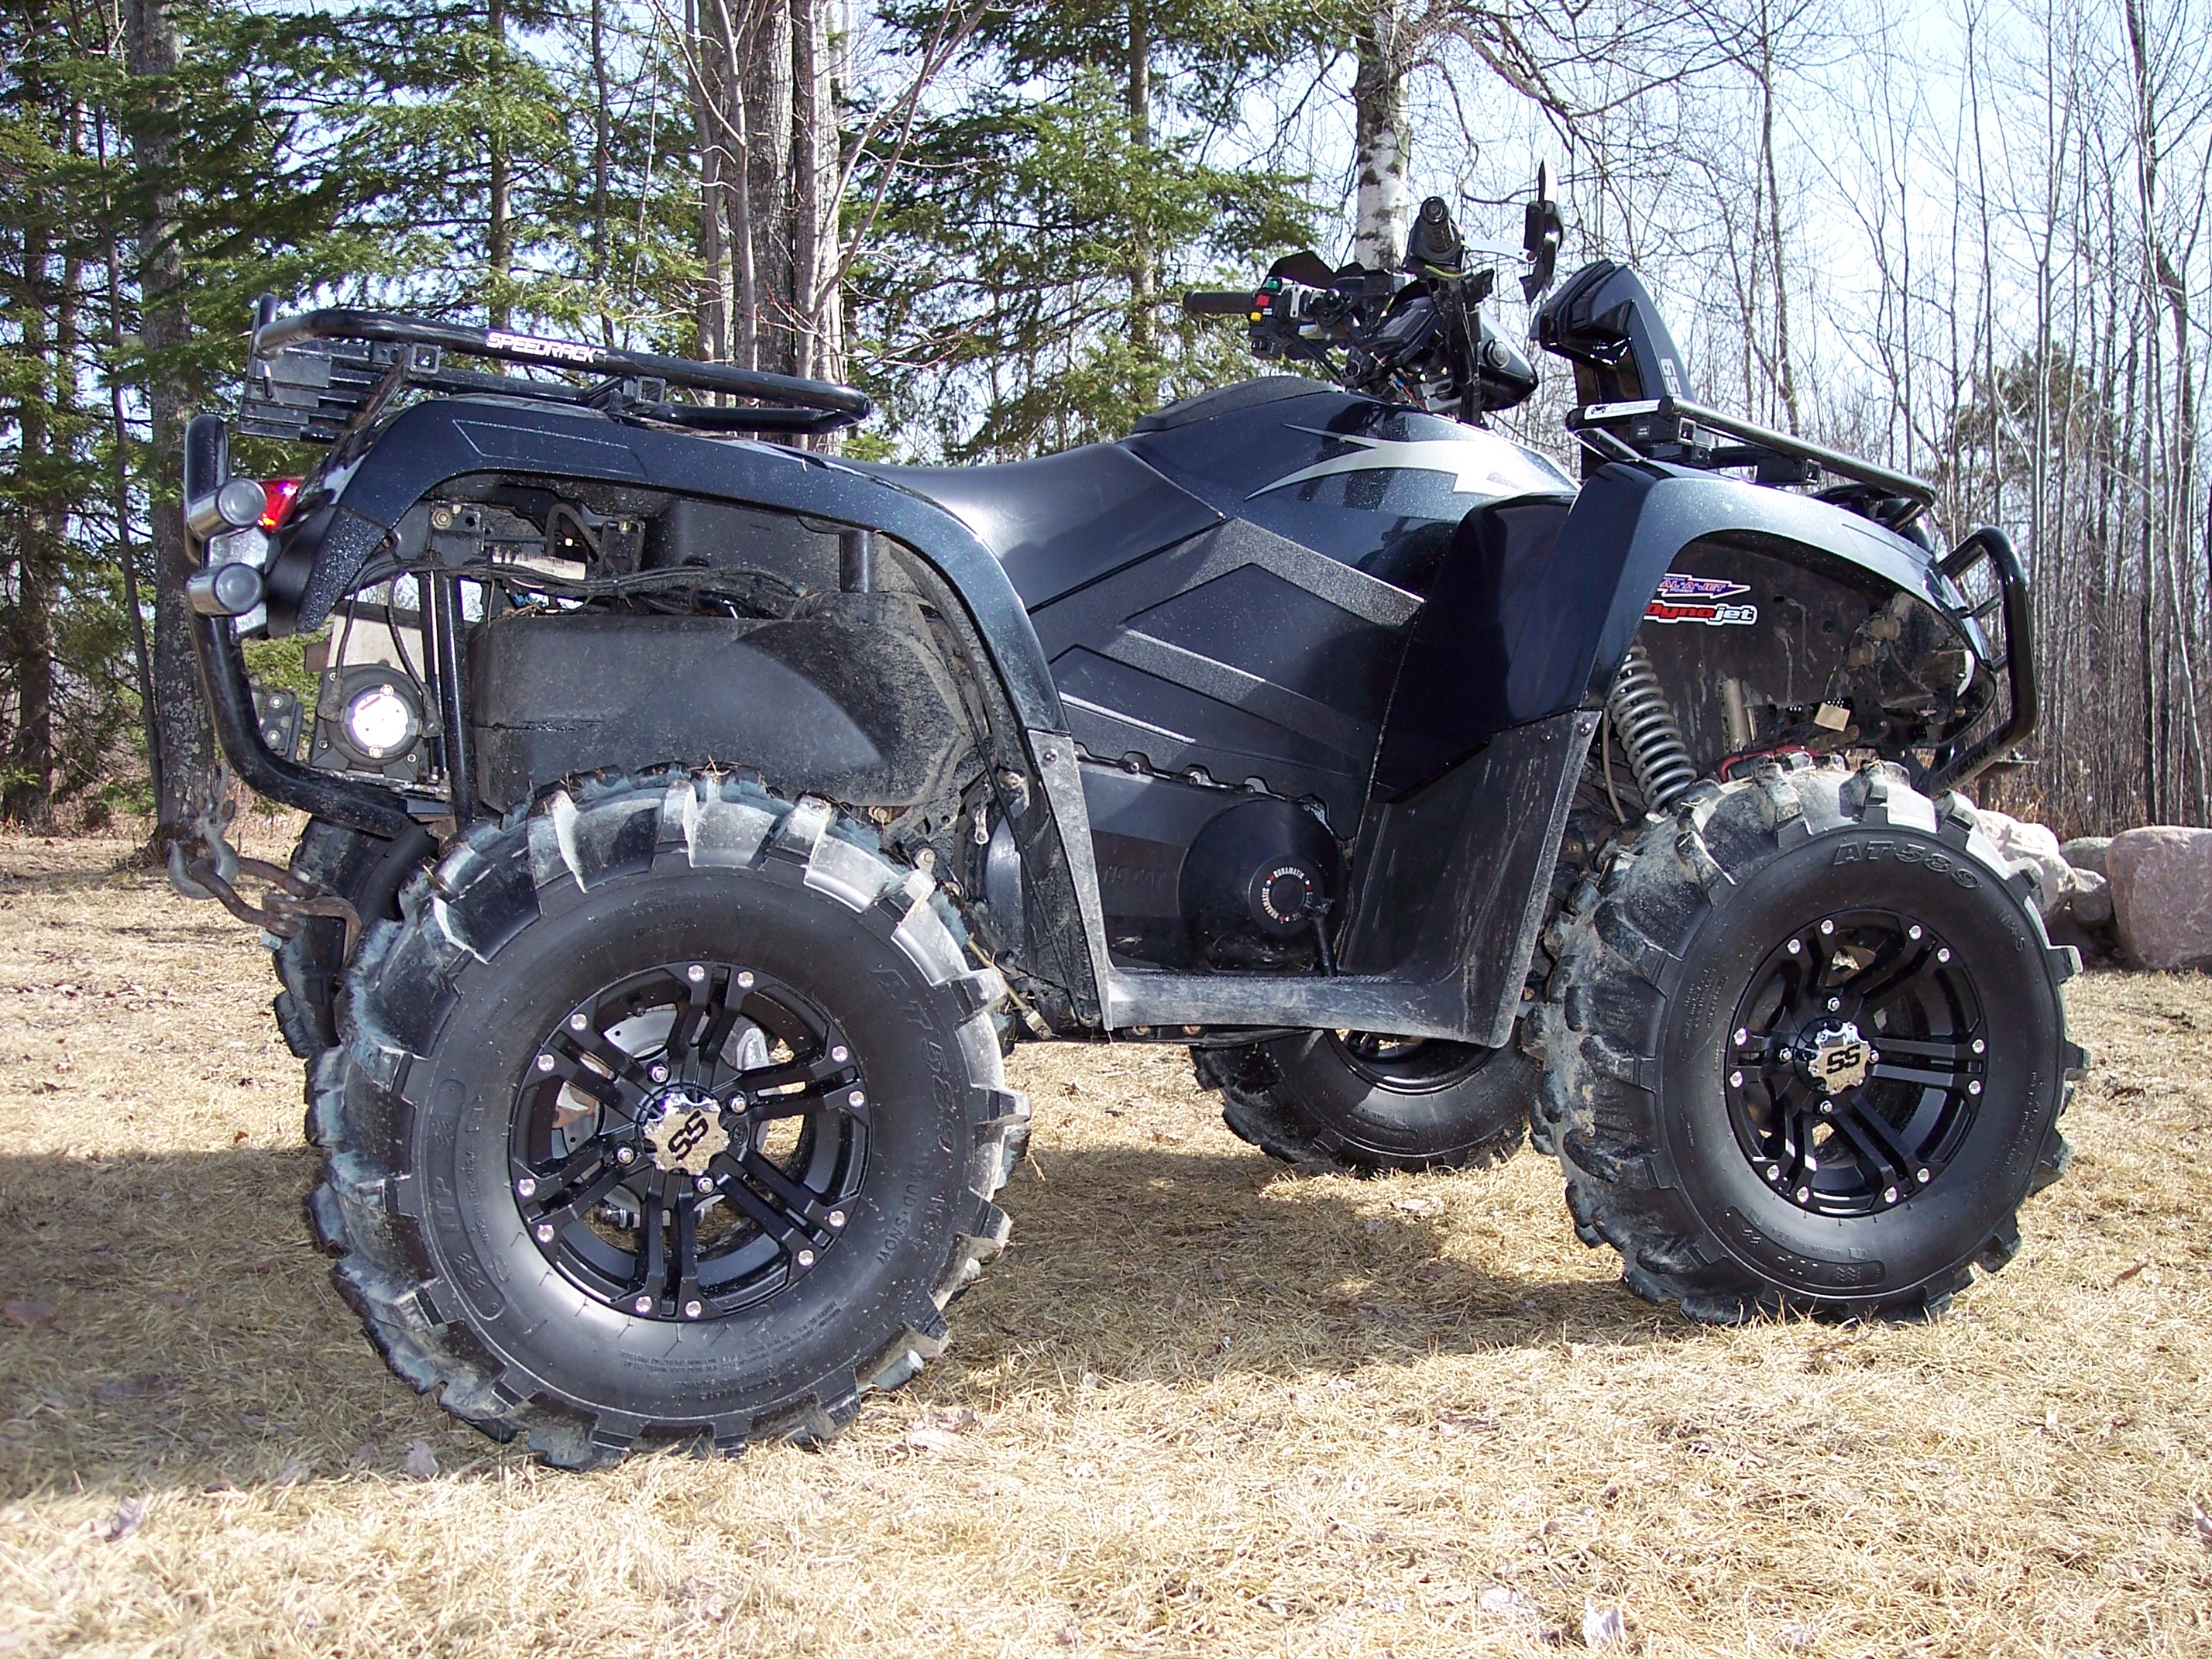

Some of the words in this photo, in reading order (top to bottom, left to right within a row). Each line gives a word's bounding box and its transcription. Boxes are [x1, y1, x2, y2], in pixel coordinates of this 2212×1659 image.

[1661, 359, 1684, 399] 65
[1646, 603, 1755, 622] Dynojet
[1826, 1043, 1861, 1075] SS
[668, 1109, 709, 1162] SS
